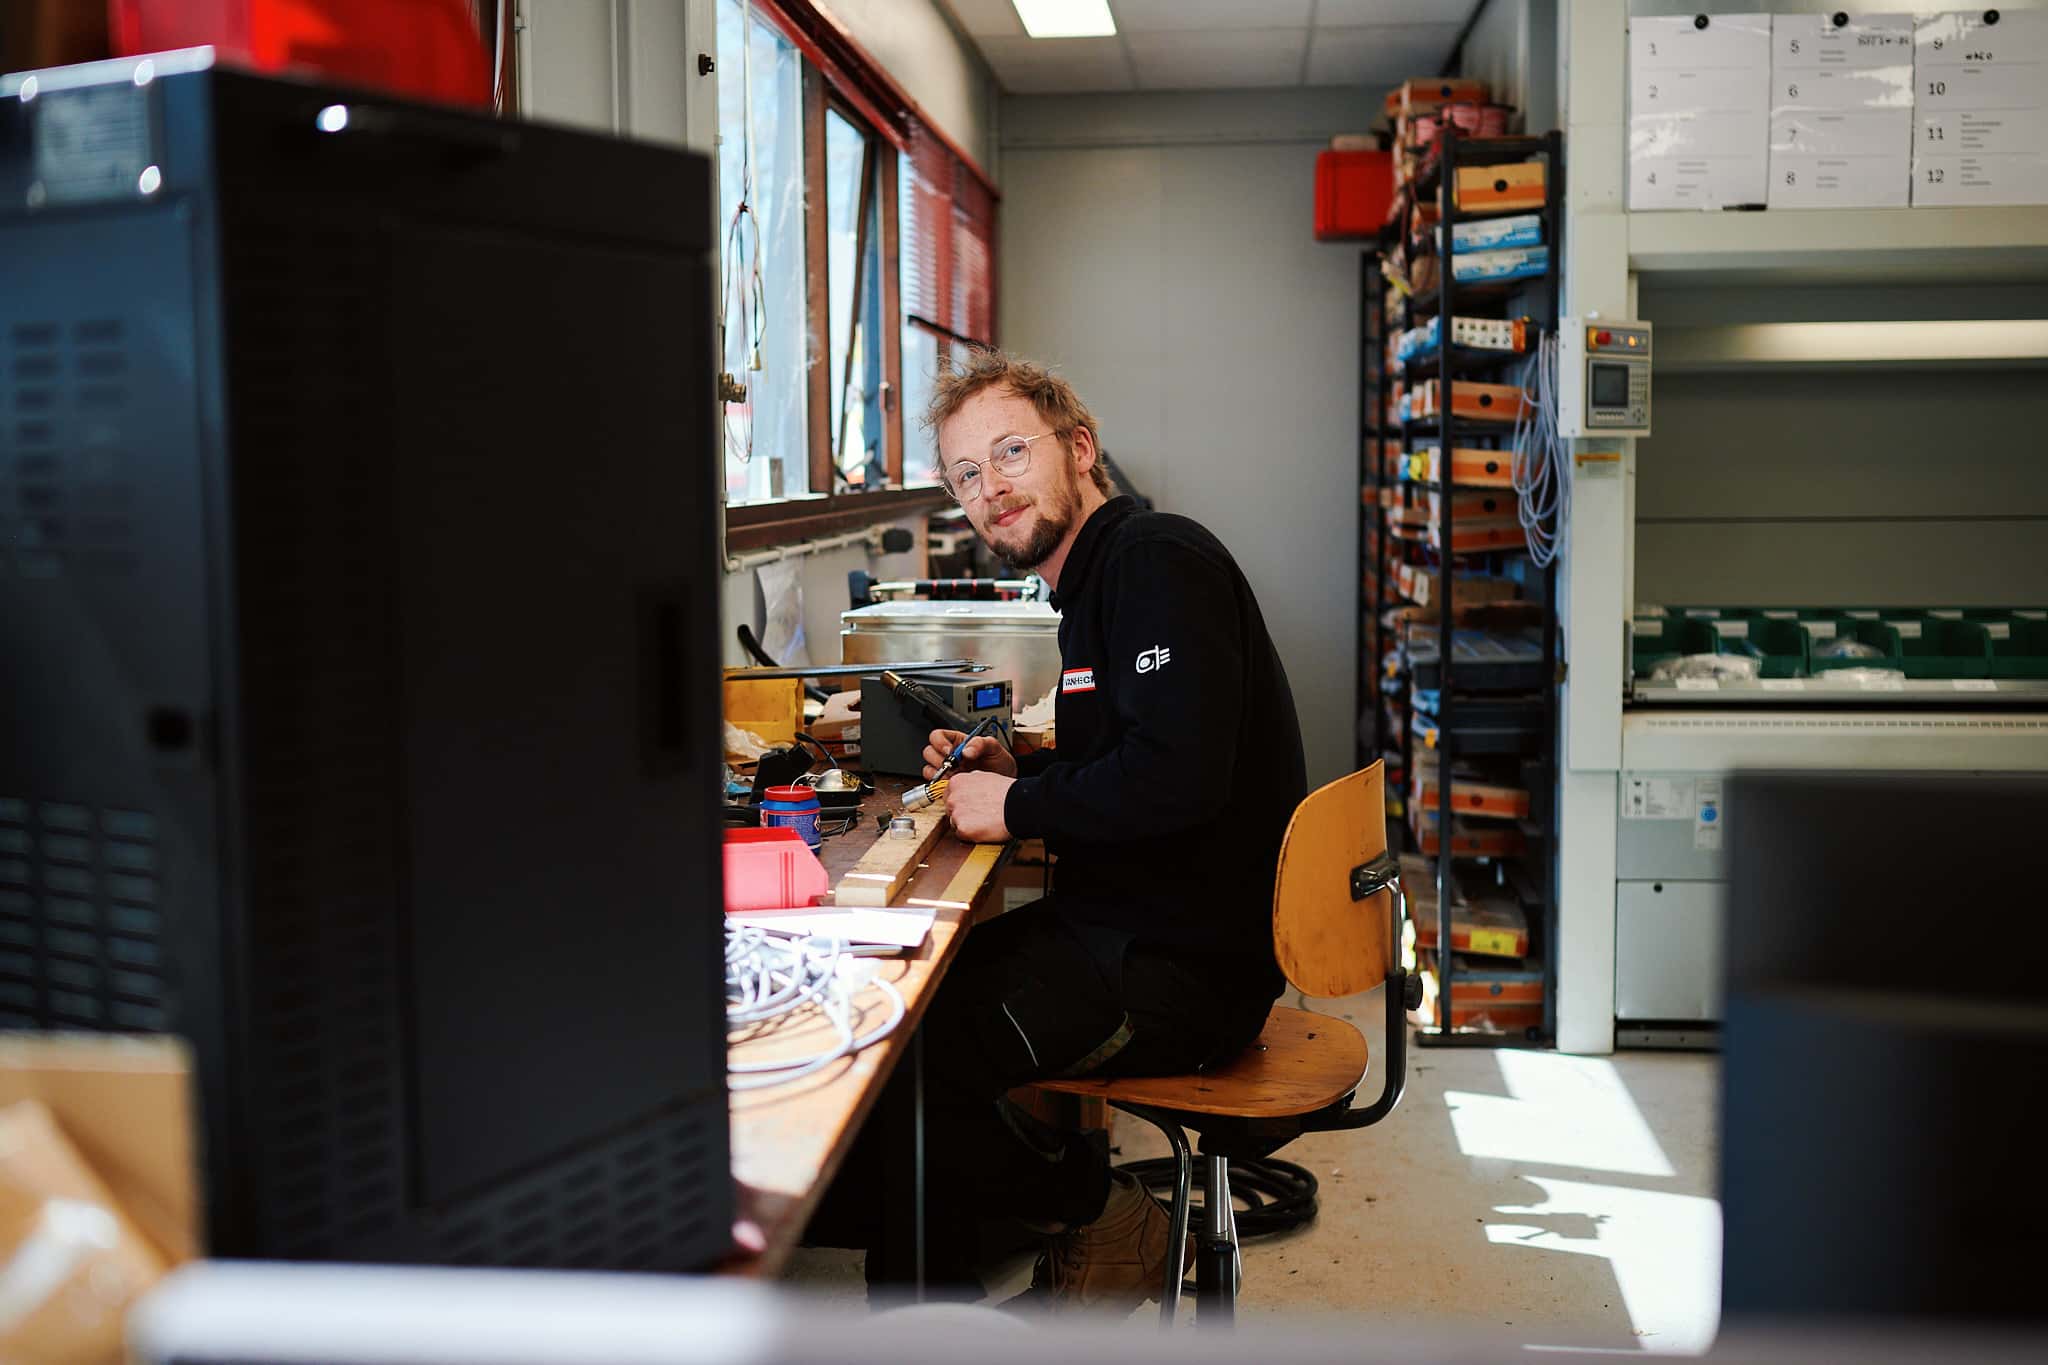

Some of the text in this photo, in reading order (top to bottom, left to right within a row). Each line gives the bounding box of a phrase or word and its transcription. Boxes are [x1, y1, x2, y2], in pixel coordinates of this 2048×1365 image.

[1790, 39, 1800, 54] 5
[1933, 38, 1944, 50] 9
[1788, 84, 1799, 98] 6
[1928, 81, 1946, 96] 10
[1787, 128, 1798, 143] 7
[1928, 127, 1944, 141] 11
[1785, 170, 1796, 185] 8
[1928, 168, 1944, 184] 12
